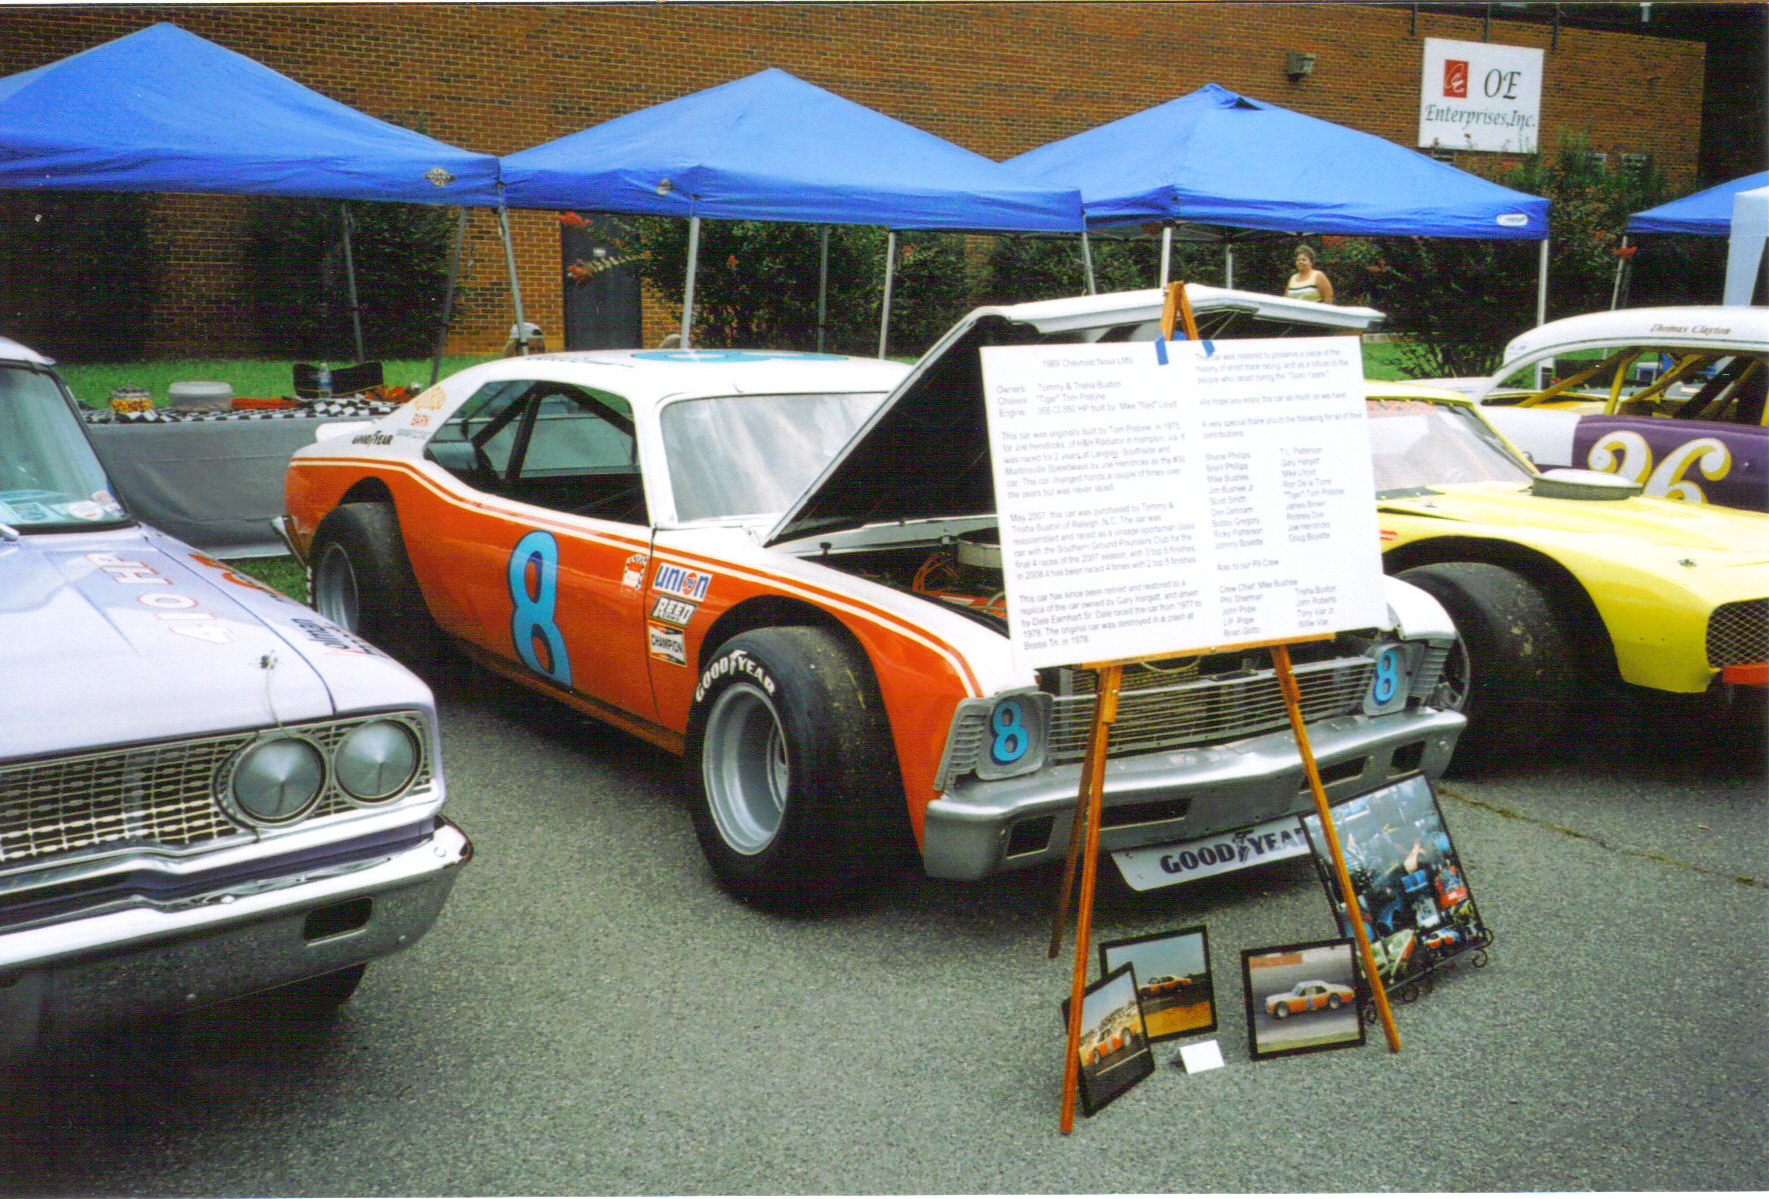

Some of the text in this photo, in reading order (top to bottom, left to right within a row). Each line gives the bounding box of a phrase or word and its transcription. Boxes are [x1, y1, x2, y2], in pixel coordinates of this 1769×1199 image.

[1485, 68, 1521, 100] OE
[507, 529, 573, 688] 8
[654, 597, 697, 625] REED
[651, 634, 684, 655] CHAMPION
[1372, 649, 1399, 706] 8
[989, 701, 1029, 766] 8
